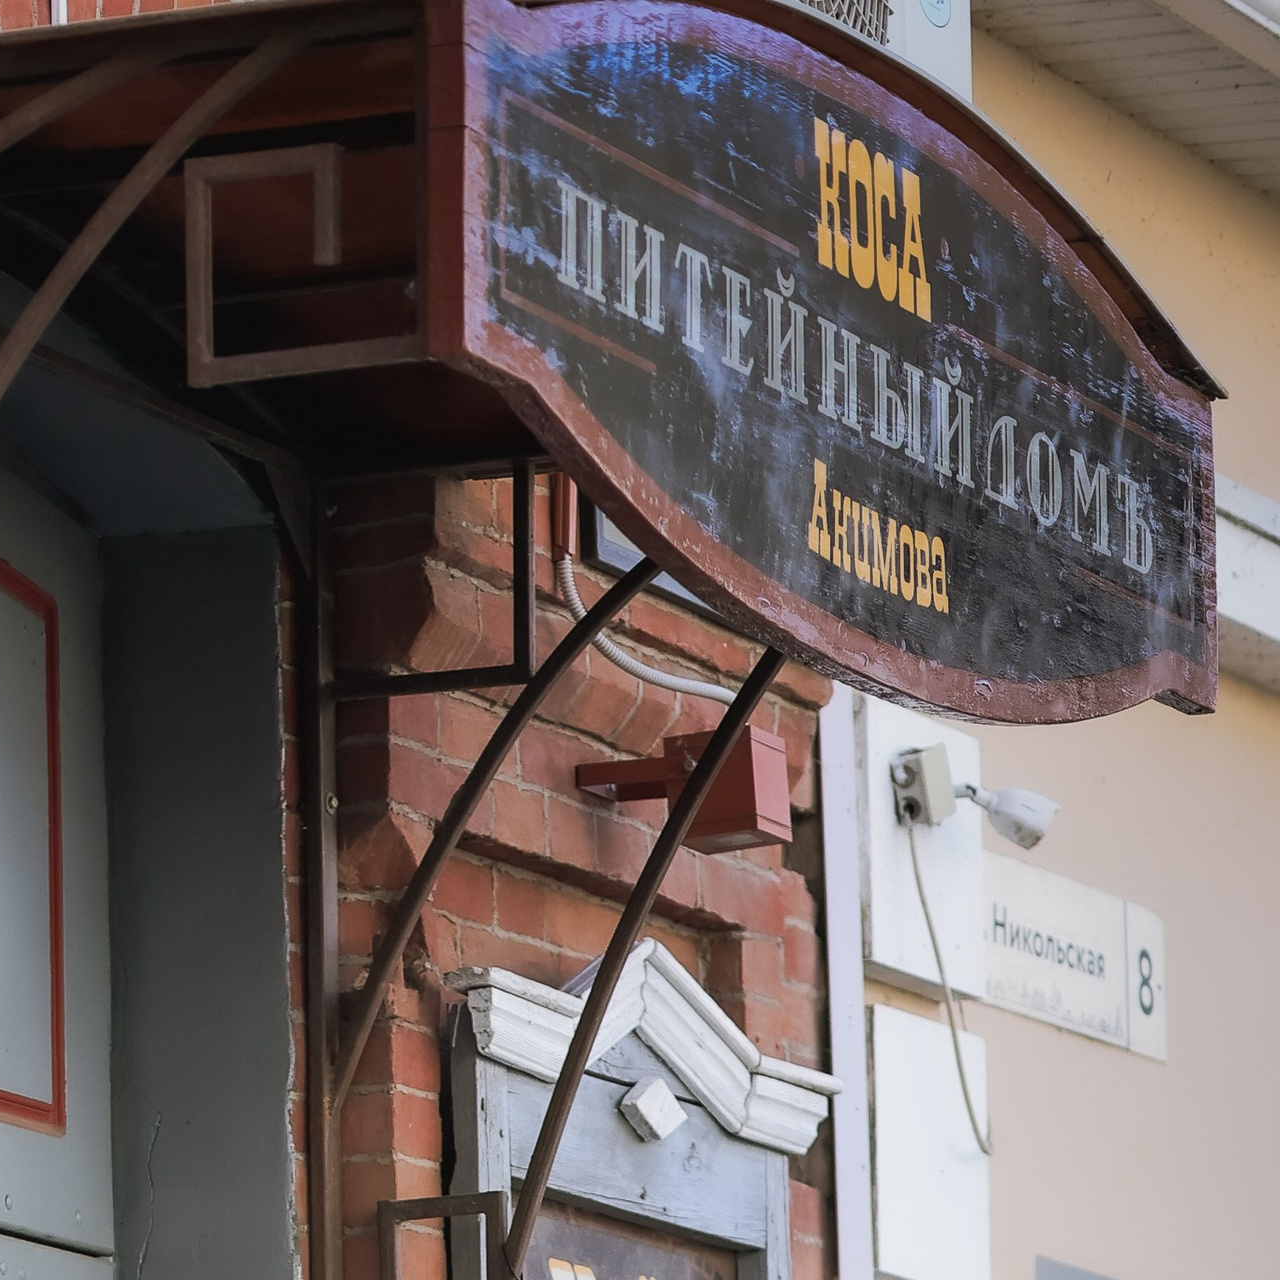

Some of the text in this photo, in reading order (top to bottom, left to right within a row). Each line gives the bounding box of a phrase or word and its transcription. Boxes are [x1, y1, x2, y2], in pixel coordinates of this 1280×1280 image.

[814, 116, 932, 323] КОСА
[556, 180, 1155, 576] ПИТЕЙНЫЙ ДОМЪ
[808, 457, 950, 614] Акимова
[992, 902, 1154, 1016] Никольская 8
